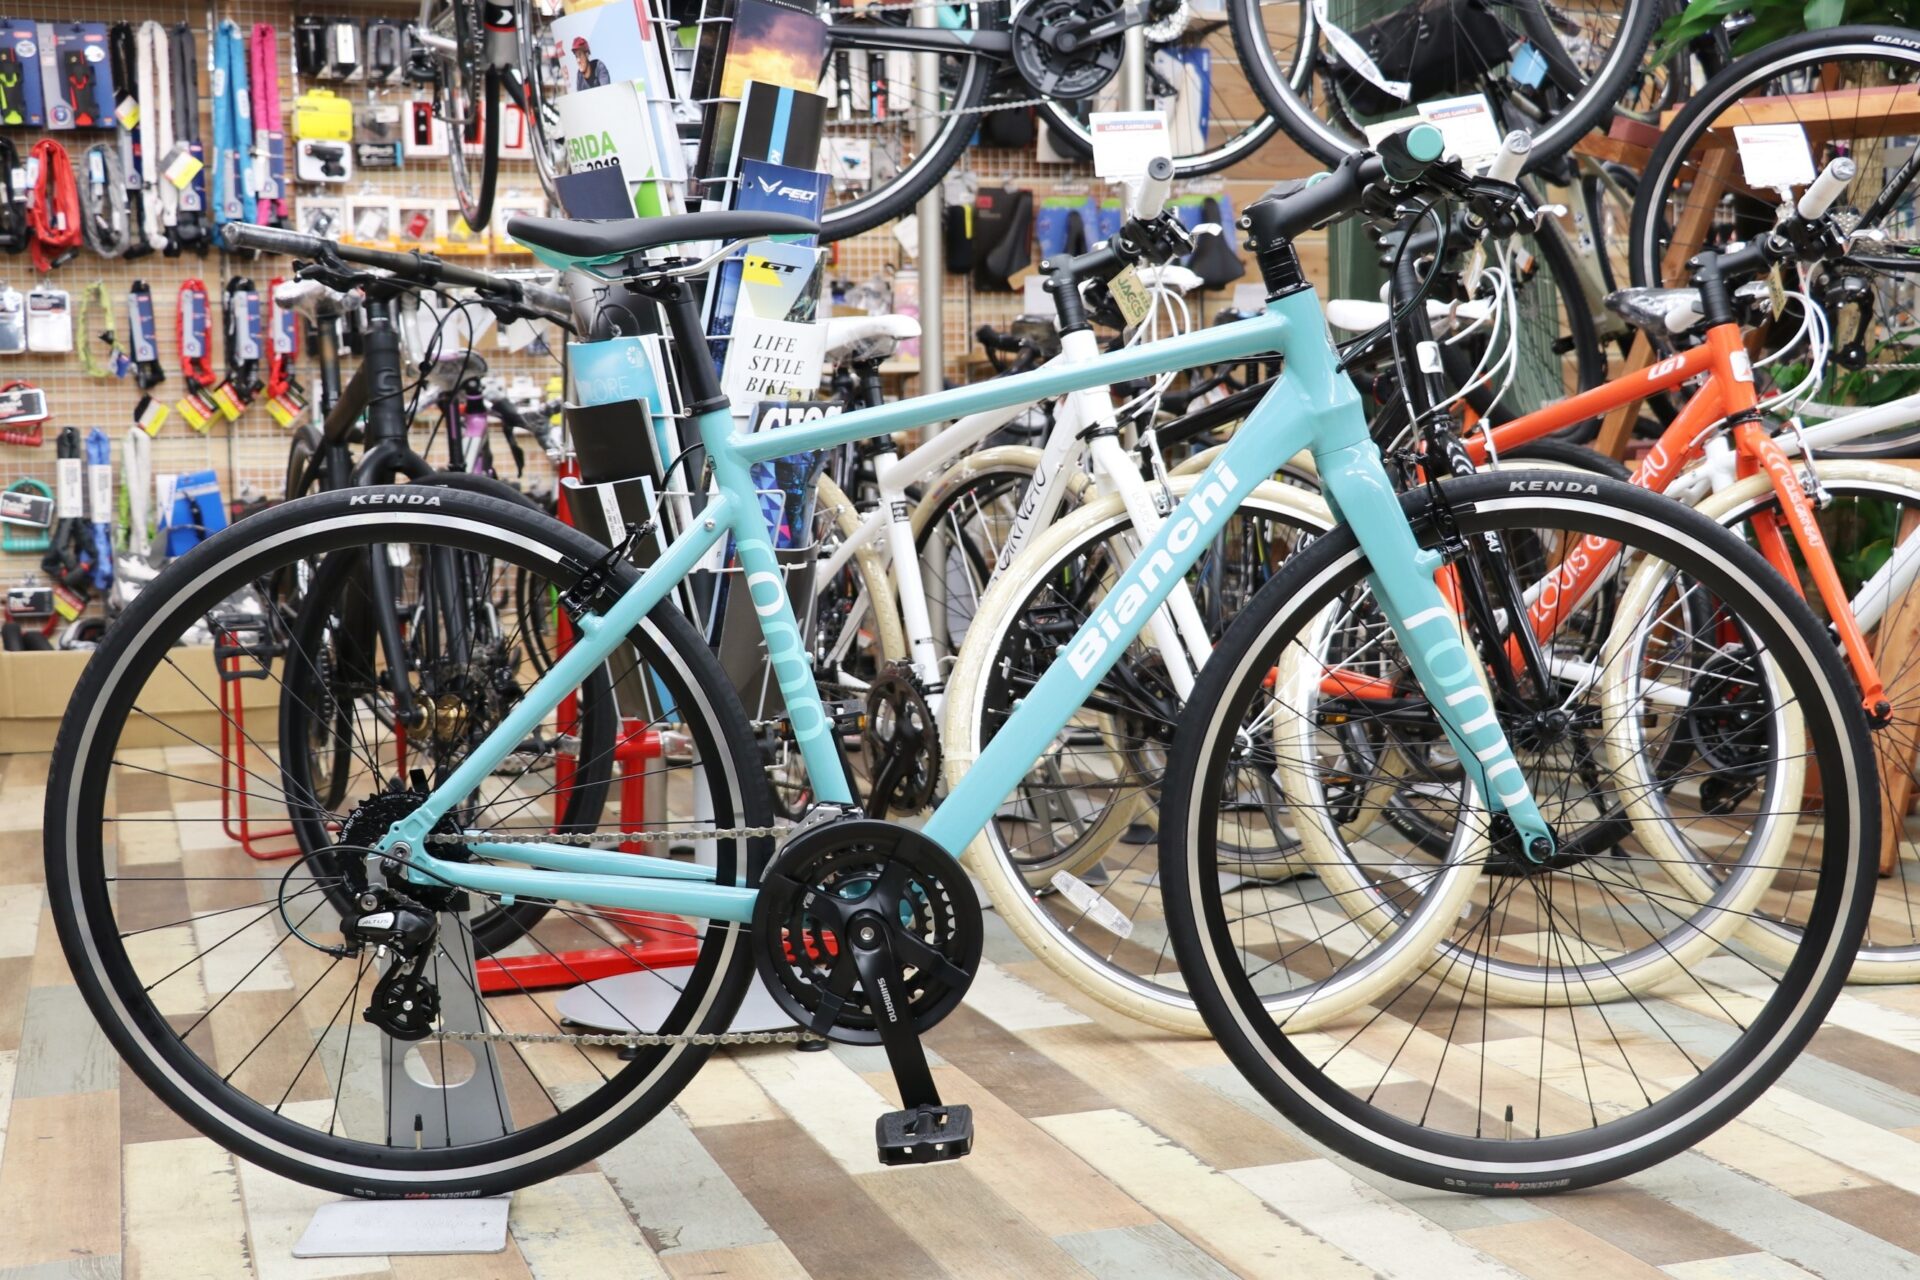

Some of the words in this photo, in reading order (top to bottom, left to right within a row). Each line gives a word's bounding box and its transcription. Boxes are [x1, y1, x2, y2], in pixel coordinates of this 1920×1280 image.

[1873, 34, 1920, 49] GIANT
[567, 130, 618, 163] ERIDA
[778, 187, 818, 201] FELT
[761, 261, 802, 274] GT
[753, 334, 797, 353] LIFE
[748, 355, 805, 375] STYLE
[1509, 481, 1598, 494] KENDA
[350, 494, 441, 506] KENDA
[1066, 460, 1239, 681] Bianchi
[1531, 545, 1590, 621] LOUIS
[877, 977, 898, 1023] SHIMANO
